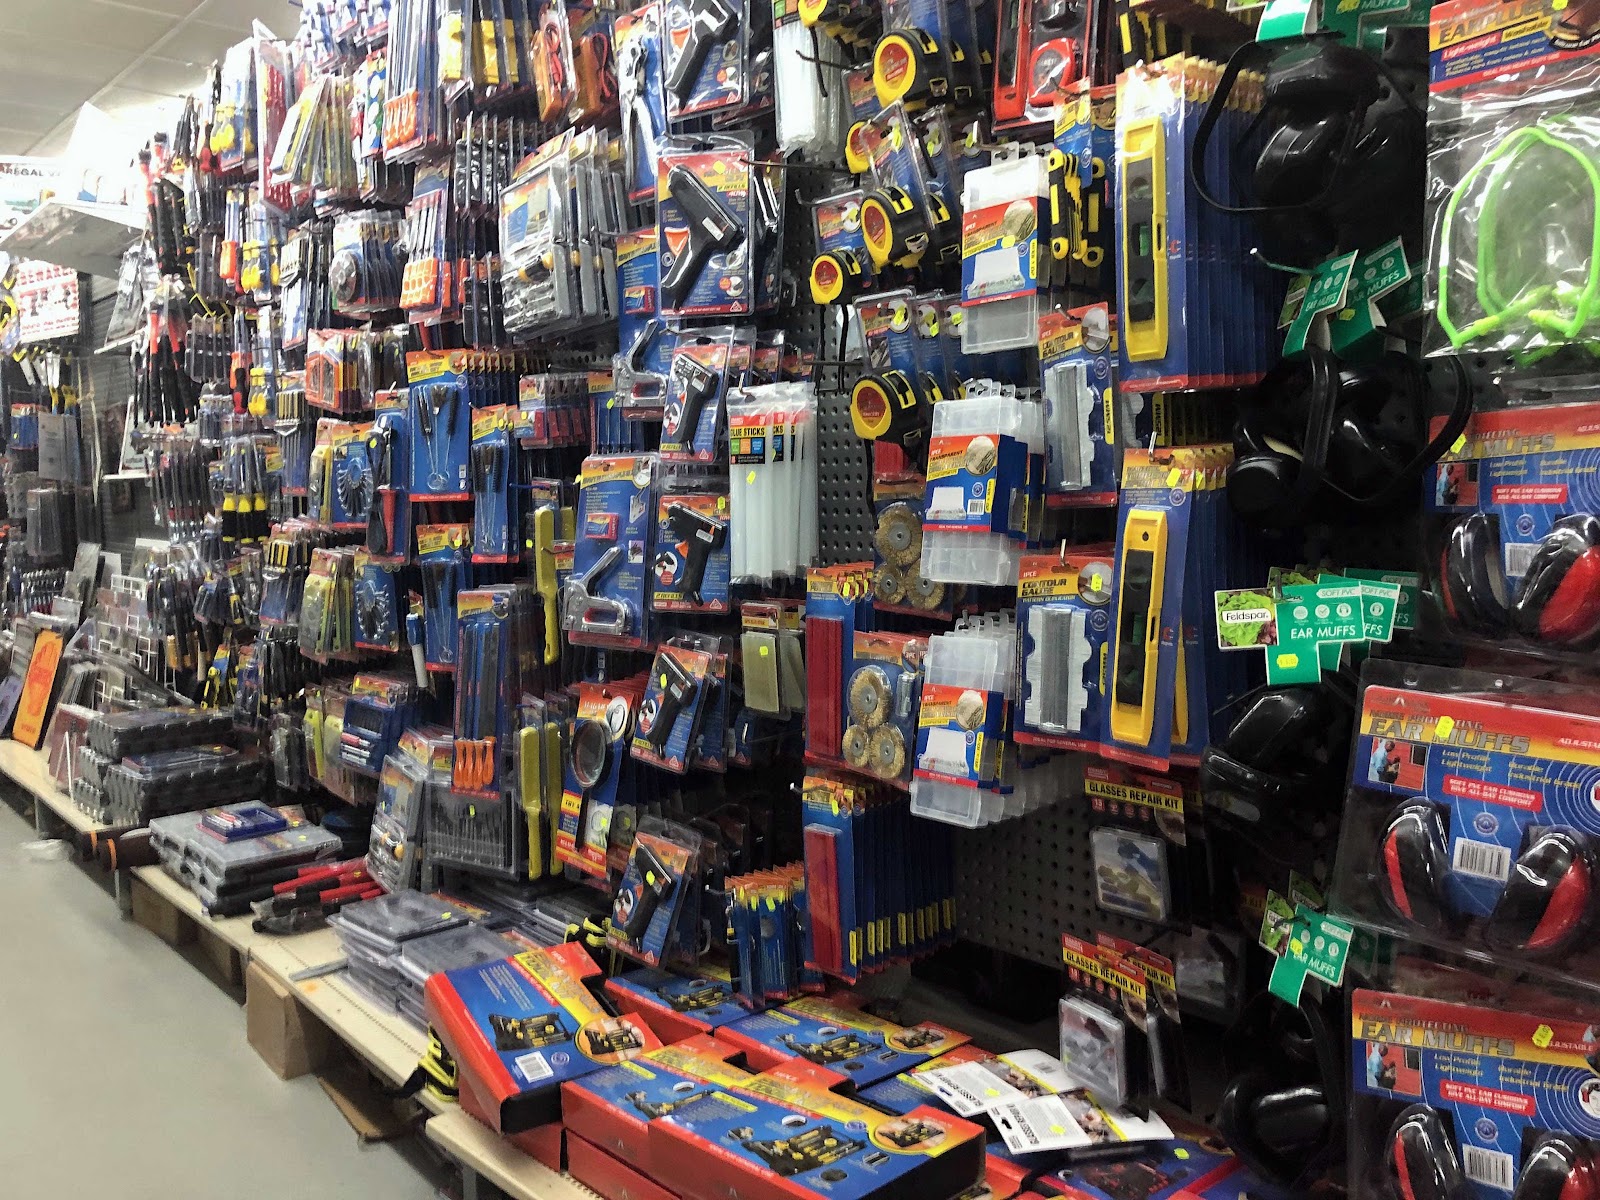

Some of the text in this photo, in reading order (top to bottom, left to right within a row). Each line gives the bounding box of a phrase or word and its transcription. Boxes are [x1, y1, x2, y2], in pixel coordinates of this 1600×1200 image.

[1367, 270, 1400, 295] MUFFS
[744, 428, 765, 436] STICKS
[1484, 434, 1556, 457] MUFFS
[1022, 579, 1067, 588] CONTOUR
[1022, 587, 1054, 596] GAUGE
[1322, 588, 1357, 597] SOFT PVC
[1290, 624, 1356, 640] EAR MUFFS
[1368, 717, 1531, 755] EAR MUFFS
[1442, 750, 1491, 762] Low Profile
[1441, 758, 1492, 773] Lightweight
[1450, 778, 1467, 787] SOFT
[1090, 782, 1179, 809] GLASSES REPAIR KIT
[1498, 794, 1533, 806] COMFORT
[1066, 951, 1142, 996] GLASSES REPAIR KIT
[1308, 956, 1336, 979] MUFFS
[1160, 974, 1172, 986] KIT
[1360, 1022, 1516, 1057] EAR MUFFS
[1434, 1053, 1481, 1066] Low Profile
[1435, 1063, 1484, 1077] Lightweight
[1446, 1083, 1463, 1092] SOFT
[1494, 1099, 1528, 1111] COMFORT
